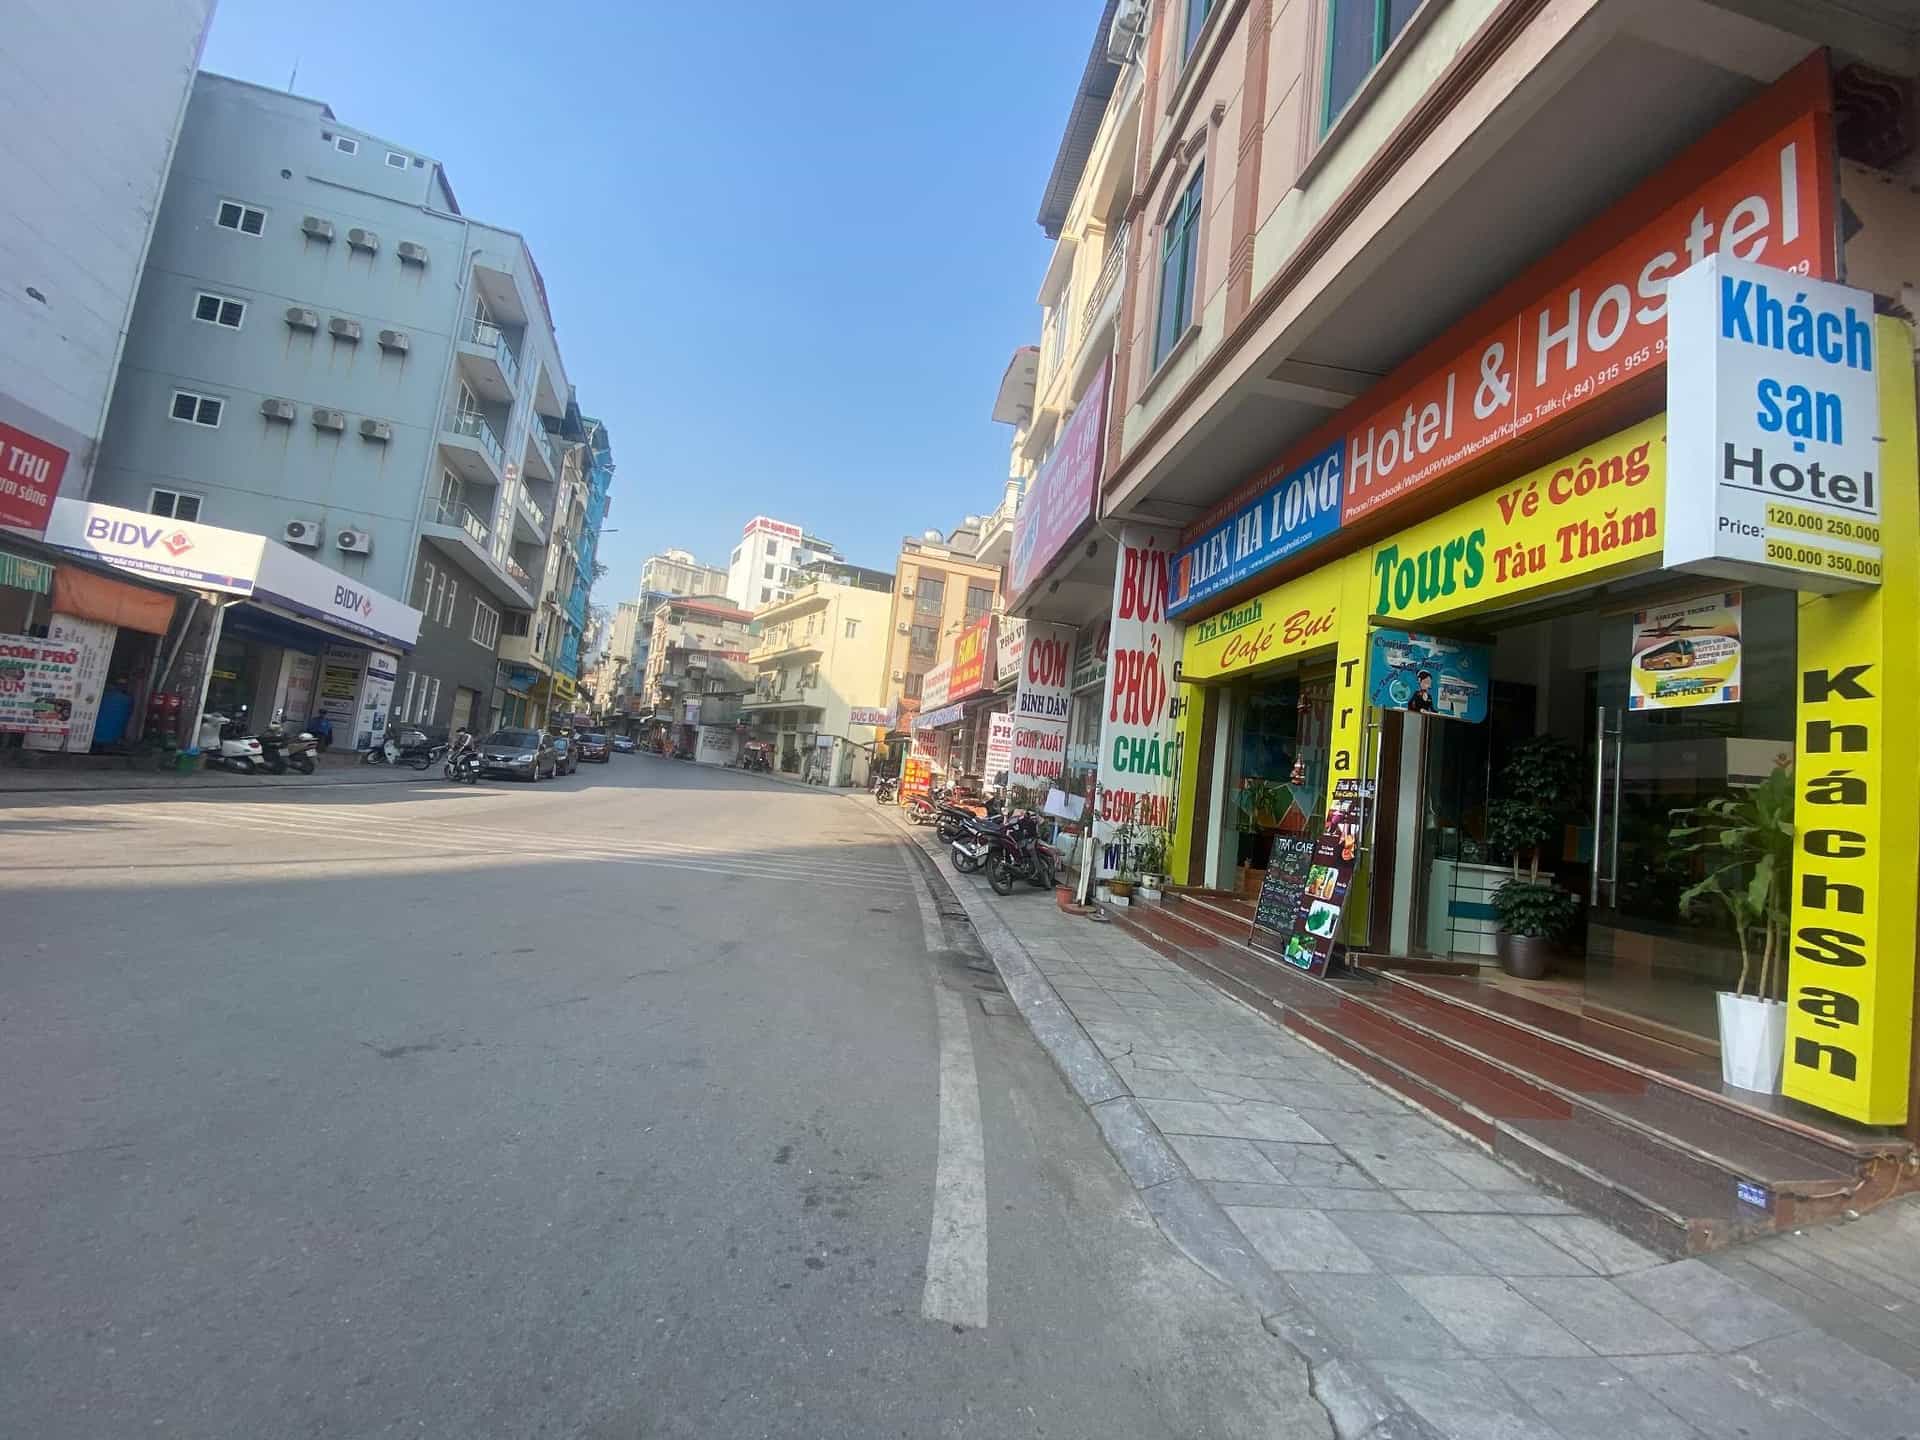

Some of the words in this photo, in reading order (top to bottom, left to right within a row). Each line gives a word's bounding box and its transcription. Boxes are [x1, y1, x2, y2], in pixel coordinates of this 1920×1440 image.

[1348, 373, 1455, 495] Hotel
[1473, 342, 1511, 420] &
[1536, 142, 1799, 387] Hostel
[1721, 276, 1872, 371] Khách
[1597, 364, 1619, 385] 915
[1624, 346, 1650, 371] 955
[1757, 378, 1842, 453] sạn
[8, 446, 51, 483] THU
[1496, 481, 1540, 525] Vé
[1548, 441, 1650, 505] Công
[1724, 442, 1874, 508] Hotel
[86, 516, 163, 549] BIDV
[1190, 526, 1231, 588] ALEX
[1235, 505, 1263, 562] HA
[1270, 452, 1340, 542] LONG
[1719, 516, 1765, 538] Price:
[1768, 507, 1823, 532] 120.000
[1827, 519, 1880, 543] 250.000
[1493, 542, 1546, 583] Tàu
[1556, 506, 1656, 564] Thăm
[1768, 544, 1822, 566] 300.000
[1828, 555, 1881, 577] 350.000
[1119, 536, 1170, 624] BÚN
[1375, 528, 1485, 616] Tours
[334, 584, 363, 612] BIDV
[1220, 599, 1262, 632] Chanh
[1028, 631, 1070, 688] CƠM
[1221, 623, 1277, 668] Café
[1284, 607, 1336, 646] Bụi
[1021, 688, 1047, 713] BÌNH
[1048, 692, 1068, 716] DÂN
[1110, 634, 1162, 726] PHỞ
[1016, 729, 1038, 750] CƠM
[1040, 729, 1064, 752] XUẤT
[1113, 733, 1176, 778] CHÁO
[1014, 756, 1035, 776] CƠM
[1103, 788, 1136, 824] CƠM
